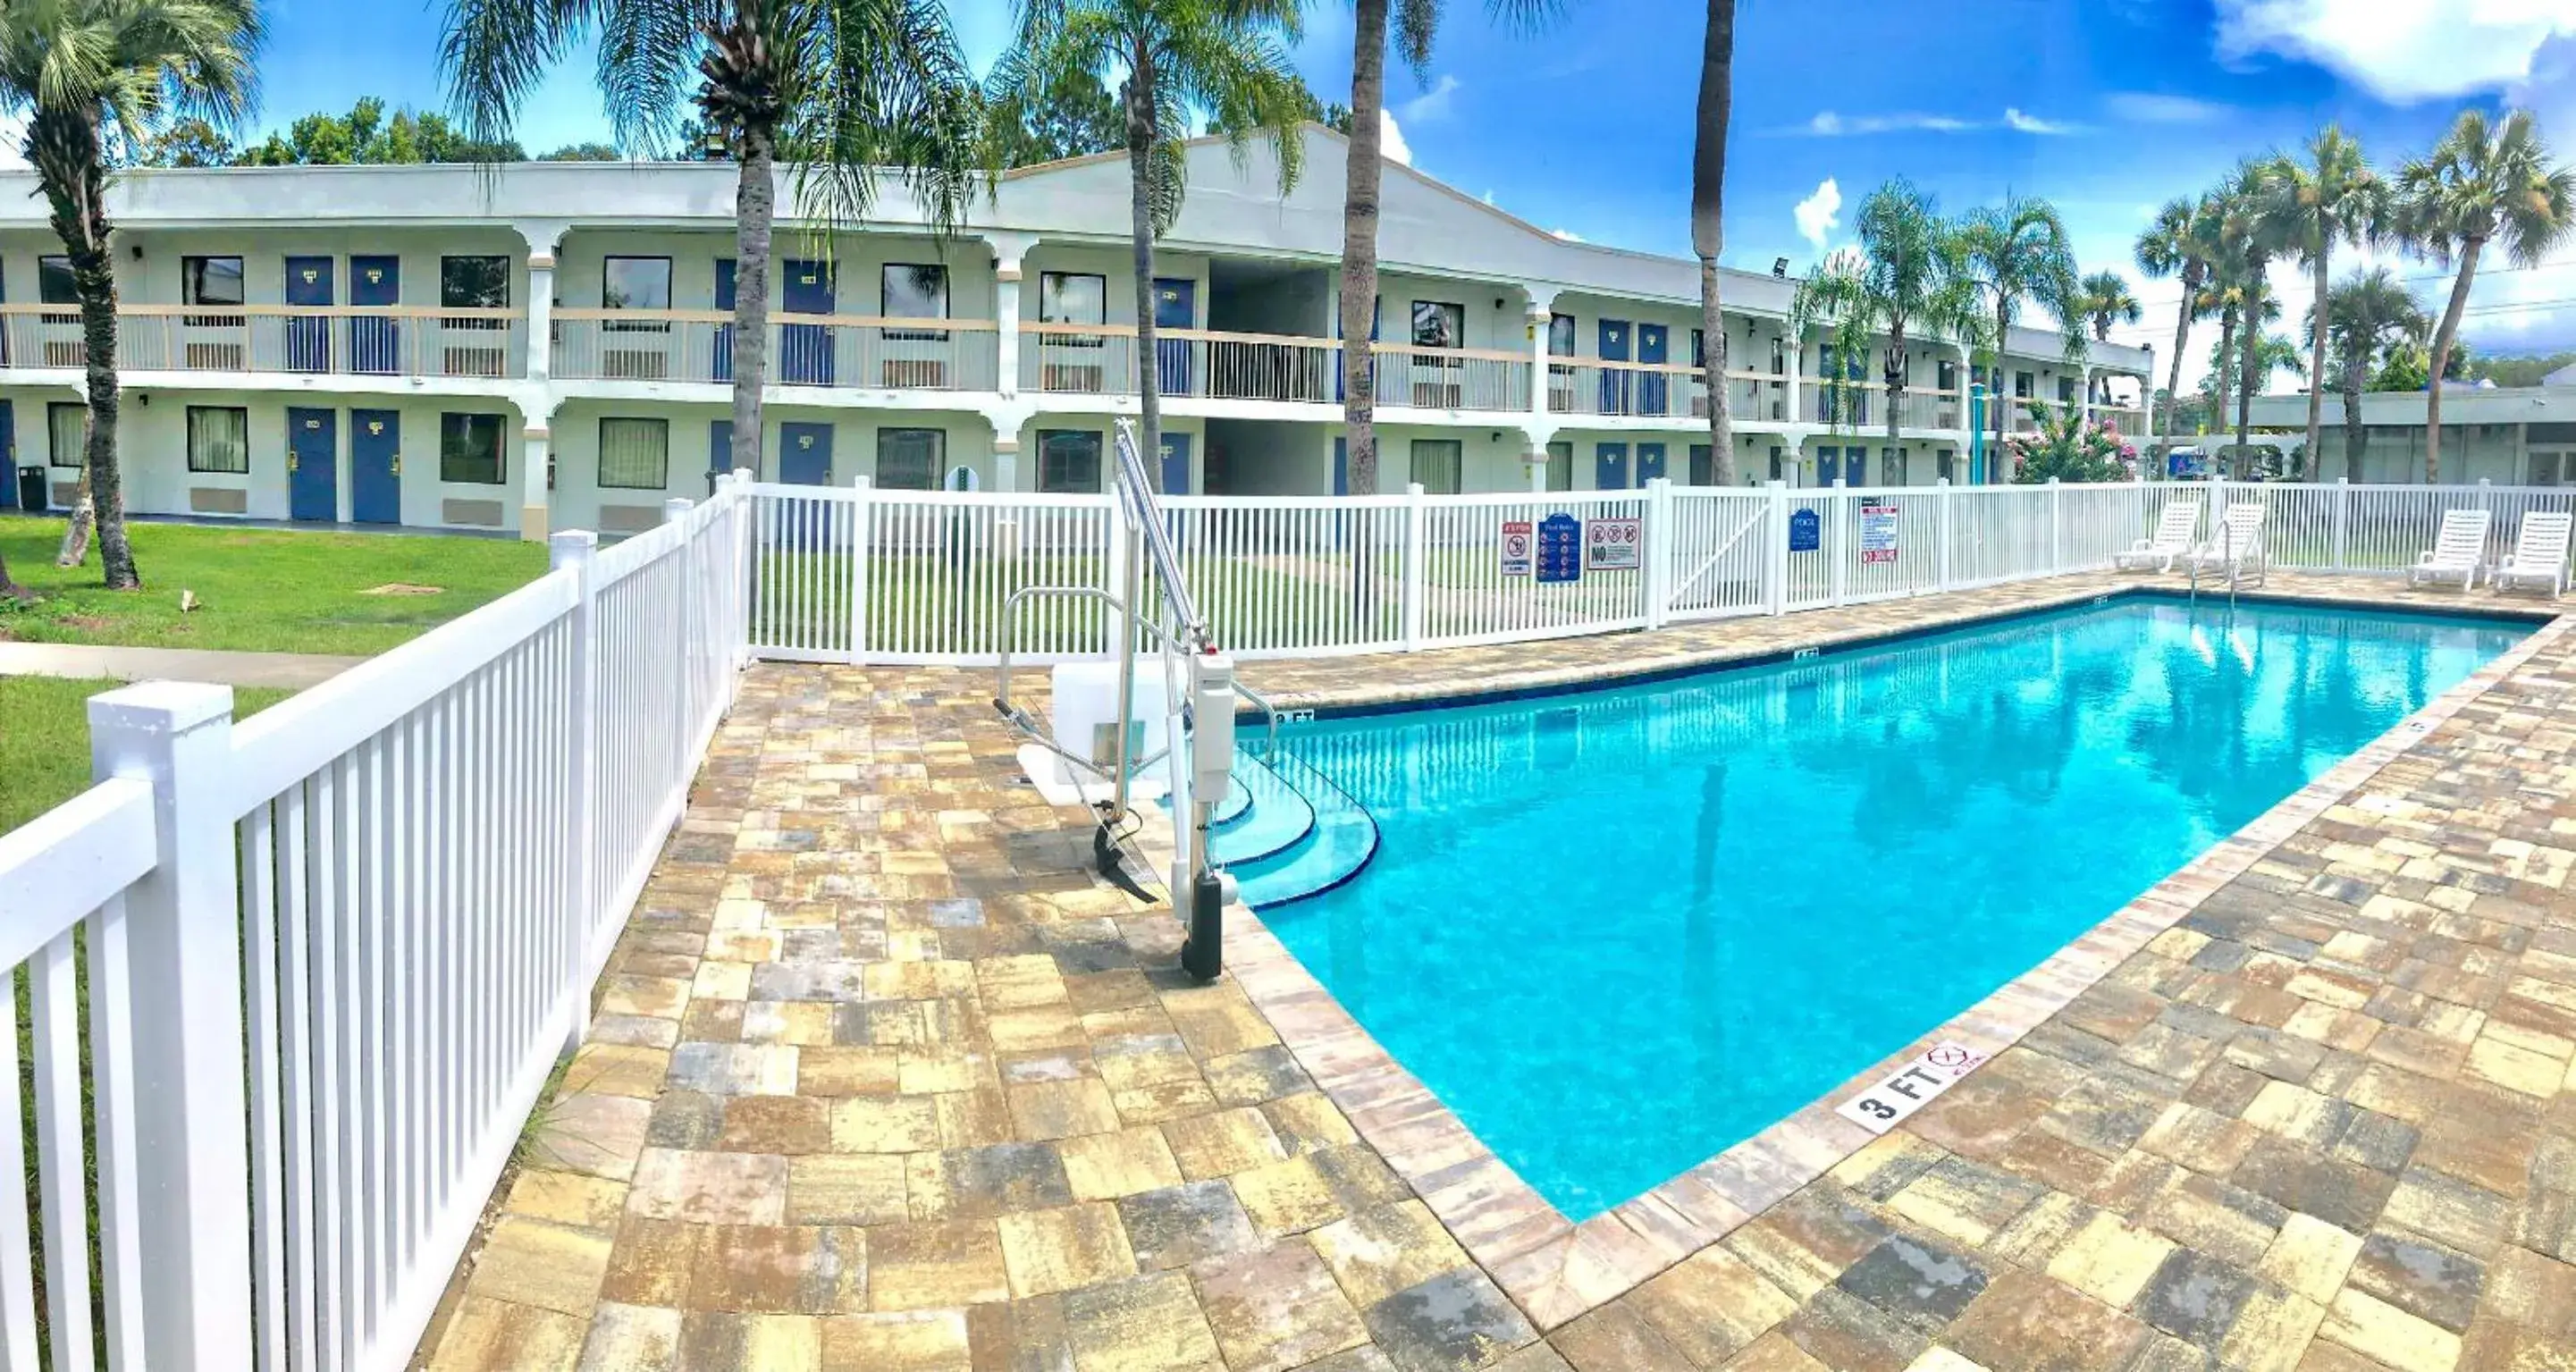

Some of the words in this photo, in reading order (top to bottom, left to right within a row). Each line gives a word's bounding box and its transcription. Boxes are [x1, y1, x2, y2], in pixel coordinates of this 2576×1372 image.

[1591, 546, 1606, 561] NO
[1292, 711, 1312, 722] FT
[1859, 1098, 1897, 1120] 3
[1886, 1066, 1942, 1100] FT
